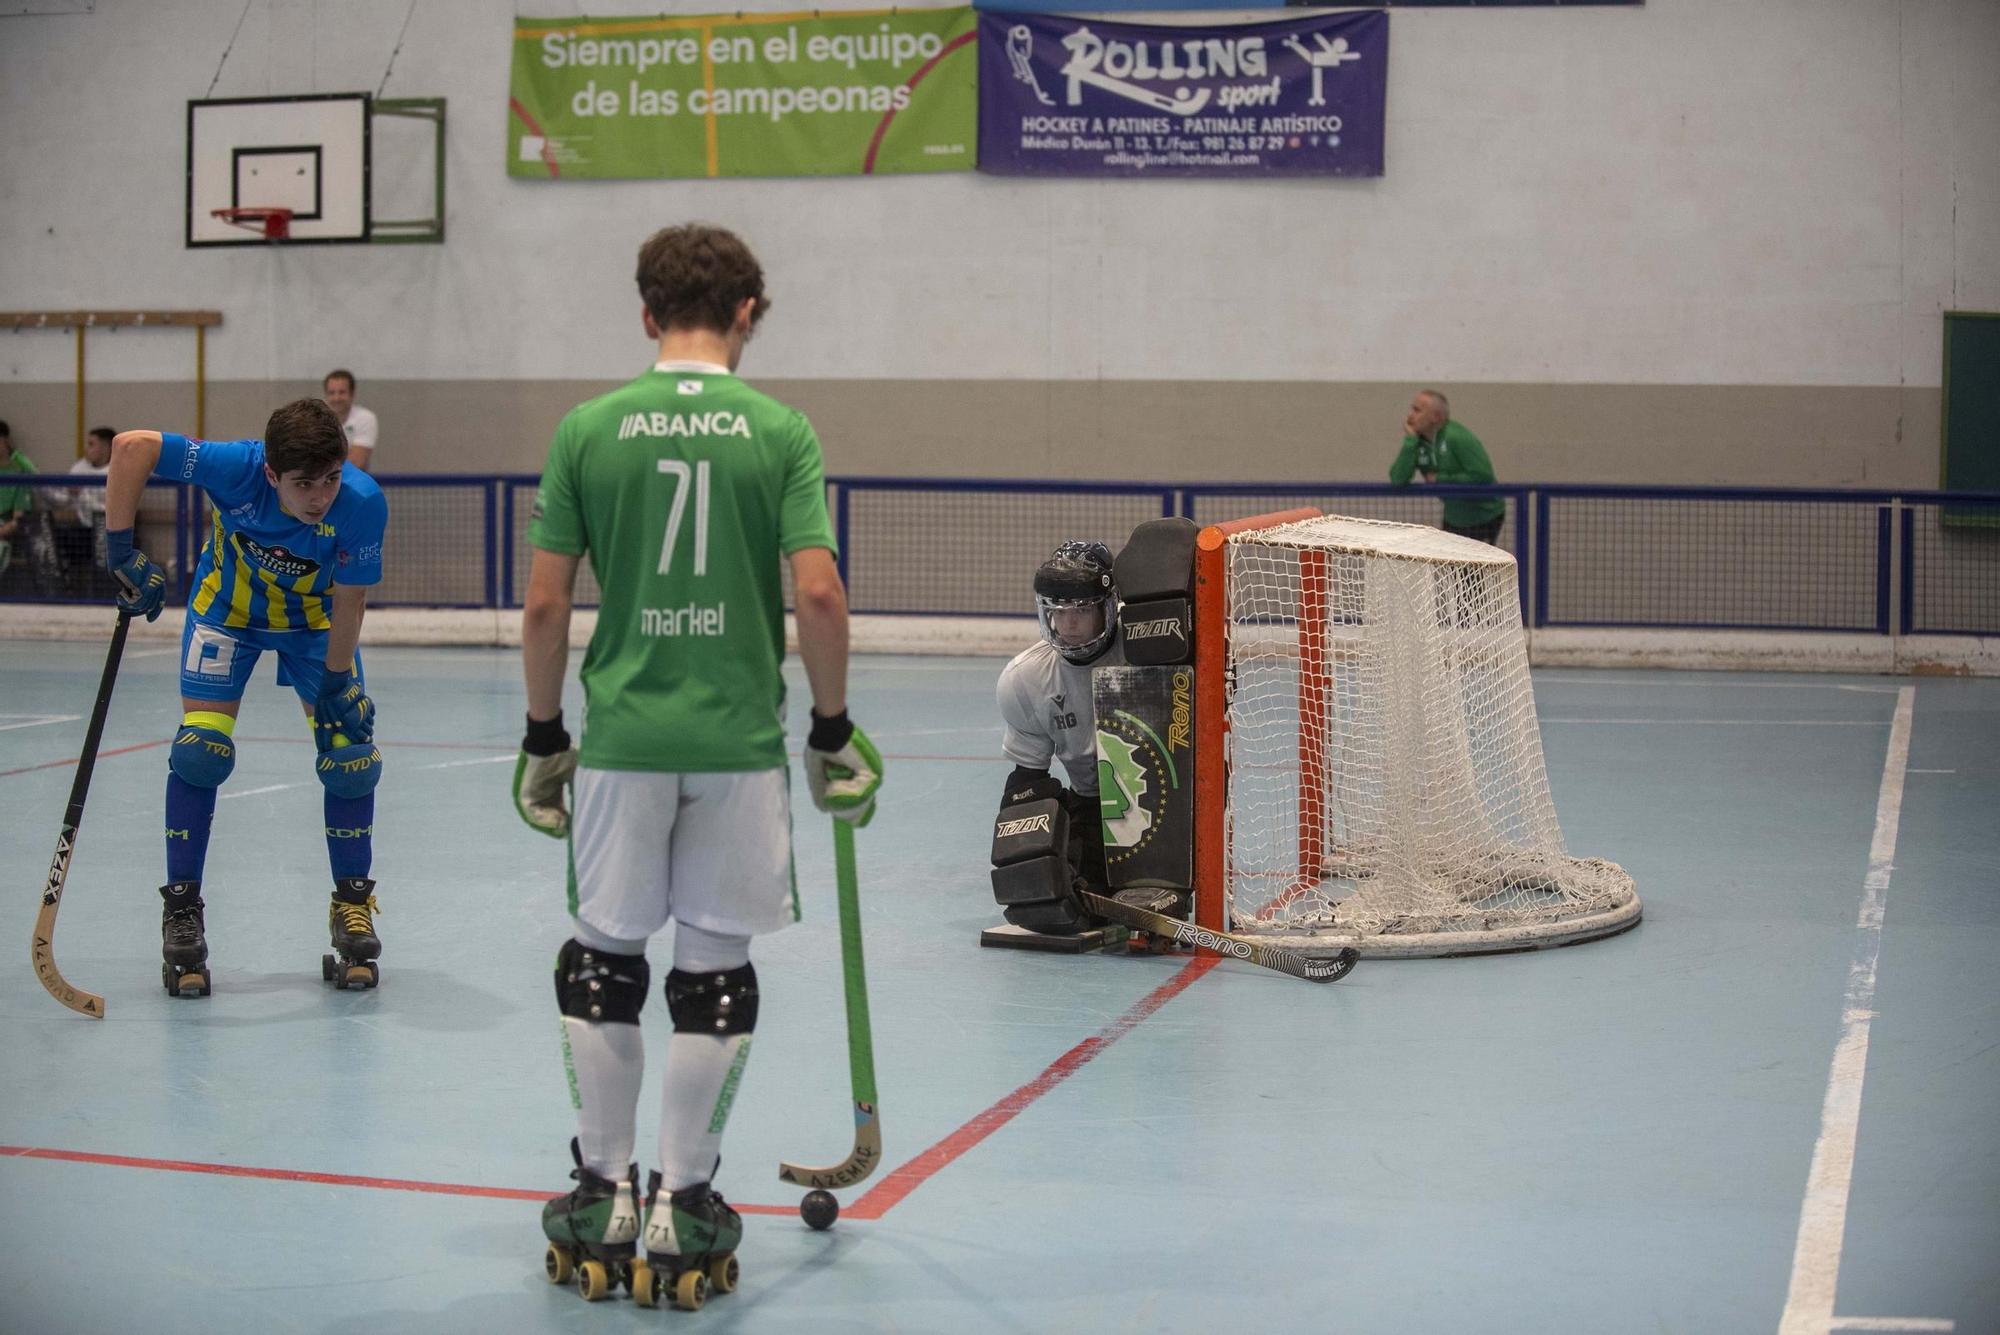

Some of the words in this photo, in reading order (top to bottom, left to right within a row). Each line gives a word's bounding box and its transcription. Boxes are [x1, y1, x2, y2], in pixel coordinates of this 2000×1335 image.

[541, 31, 699, 74] Siempre
[707, 36, 755, 63] en
[763, 26, 797, 62] el
[806, 23, 941, 70] equipo
[1060, 27, 1269, 106] ROLLING
[572, 80, 620, 116] de
[629, 80, 678, 116] las
[687, 84, 911, 122] campeonas
[1217, 76, 1281, 112] sport
[1021, 116, 1089, 134] HOCKEY
[1092, 116, 1104, 134] A
[1107, 117, 1171, 135] PATINES
[1183, 116, 1257, 134] PATINAJE
[1260, 112, 1342, 133] ARTÍSTICO
[183, 440, 201, 479] Acteo
[656, 458, 710, 577] 71
[641, 602, 725, 637] markel
[1054, 711, 1078, 730] HG
[1168, 672, 1190, 754] Reno
[338, 756, 371, 774] TVD
[325, 824, 373, 839] CDM
[43, 833, 72, 902] AZEX
[1166, 918, 1252, 959] Reno
[615, 1216, 636, 1232] 71
[650, 1225, 670, 1241] 71
